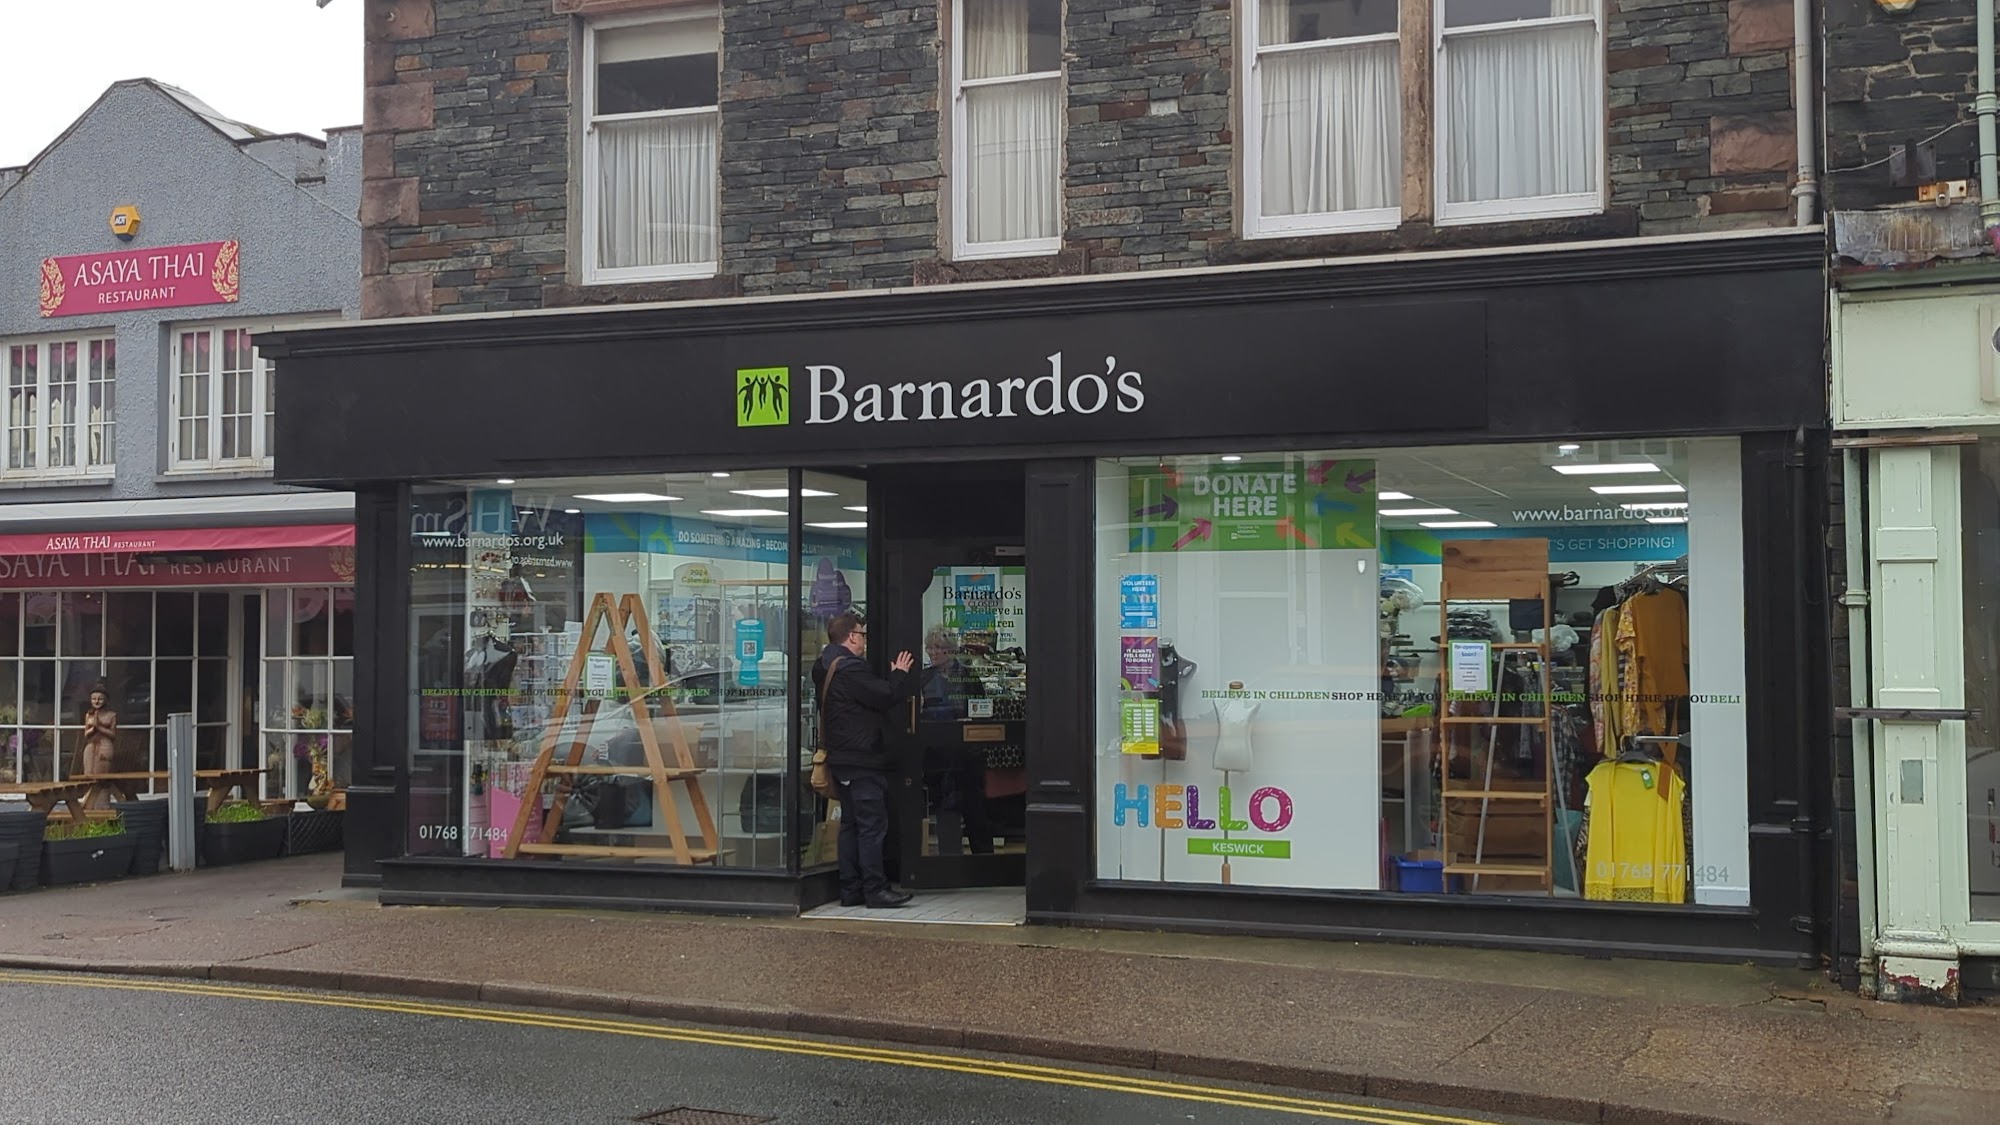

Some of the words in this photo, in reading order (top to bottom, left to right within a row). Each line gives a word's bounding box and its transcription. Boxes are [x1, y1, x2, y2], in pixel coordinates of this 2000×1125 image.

[114, 215, 127, 225] ADT
[73, 257, 142, 287] ASAYA
[148, 252, 204, 279] THAI
[98, 286, 176, 304] RESTAURANT
[804, 351, 1145, 424] Barnardo's
[1193, 473, 1297, 496] DONATE
[1213, 496, 1278, 518] HERE
[46, 537, 80, 550] ASAYA
[83, 535, 111, 549] THAI
[114, 540, 156, 548] RESTAURANT
[422, 532, 565, 550] www.barnardos.org.uk
[678, 531, 690, 543] DO
[731, 536, 761, 549] AMAZING
[765, 540, 788, 552] BECOM
[1568, 538, 1594, 550] GET
[1597, 536, 1675, 550] SHOPPING!
[943, 586, 1022, 600] Barnardo's
[1013, 606, 1024, 615] in
[422, 688, 460, 696] BELIEVE
[462, 688, 472, 696] IN
[473, 688, 519, 696] CHILDREN
[586, 688, 605, 697] YOU
[712, 688, 736, 697] HOP
[738, 688, 766, 697] HERE
[768, 688, 778, 697] IF
[1202, 690, 1251, 699] BELIEVE
[1254, 690, 1267, 699] IN
[1270, 690, 1331, 700] CHILDREN
[1332, 692, 1363, 701] SHOP
[1367, 692, 1400, 701] HERE
[1502, 692, 1516, 702] IN
[1114, 783, 1293, 832] HELLO
[419, 825, 458, 840] 01768
[1212, 842, 1265, 854] KESWICK
[1595, 862, 1653, 880] 01768
[1660, 864, 1730, 883] 771484
